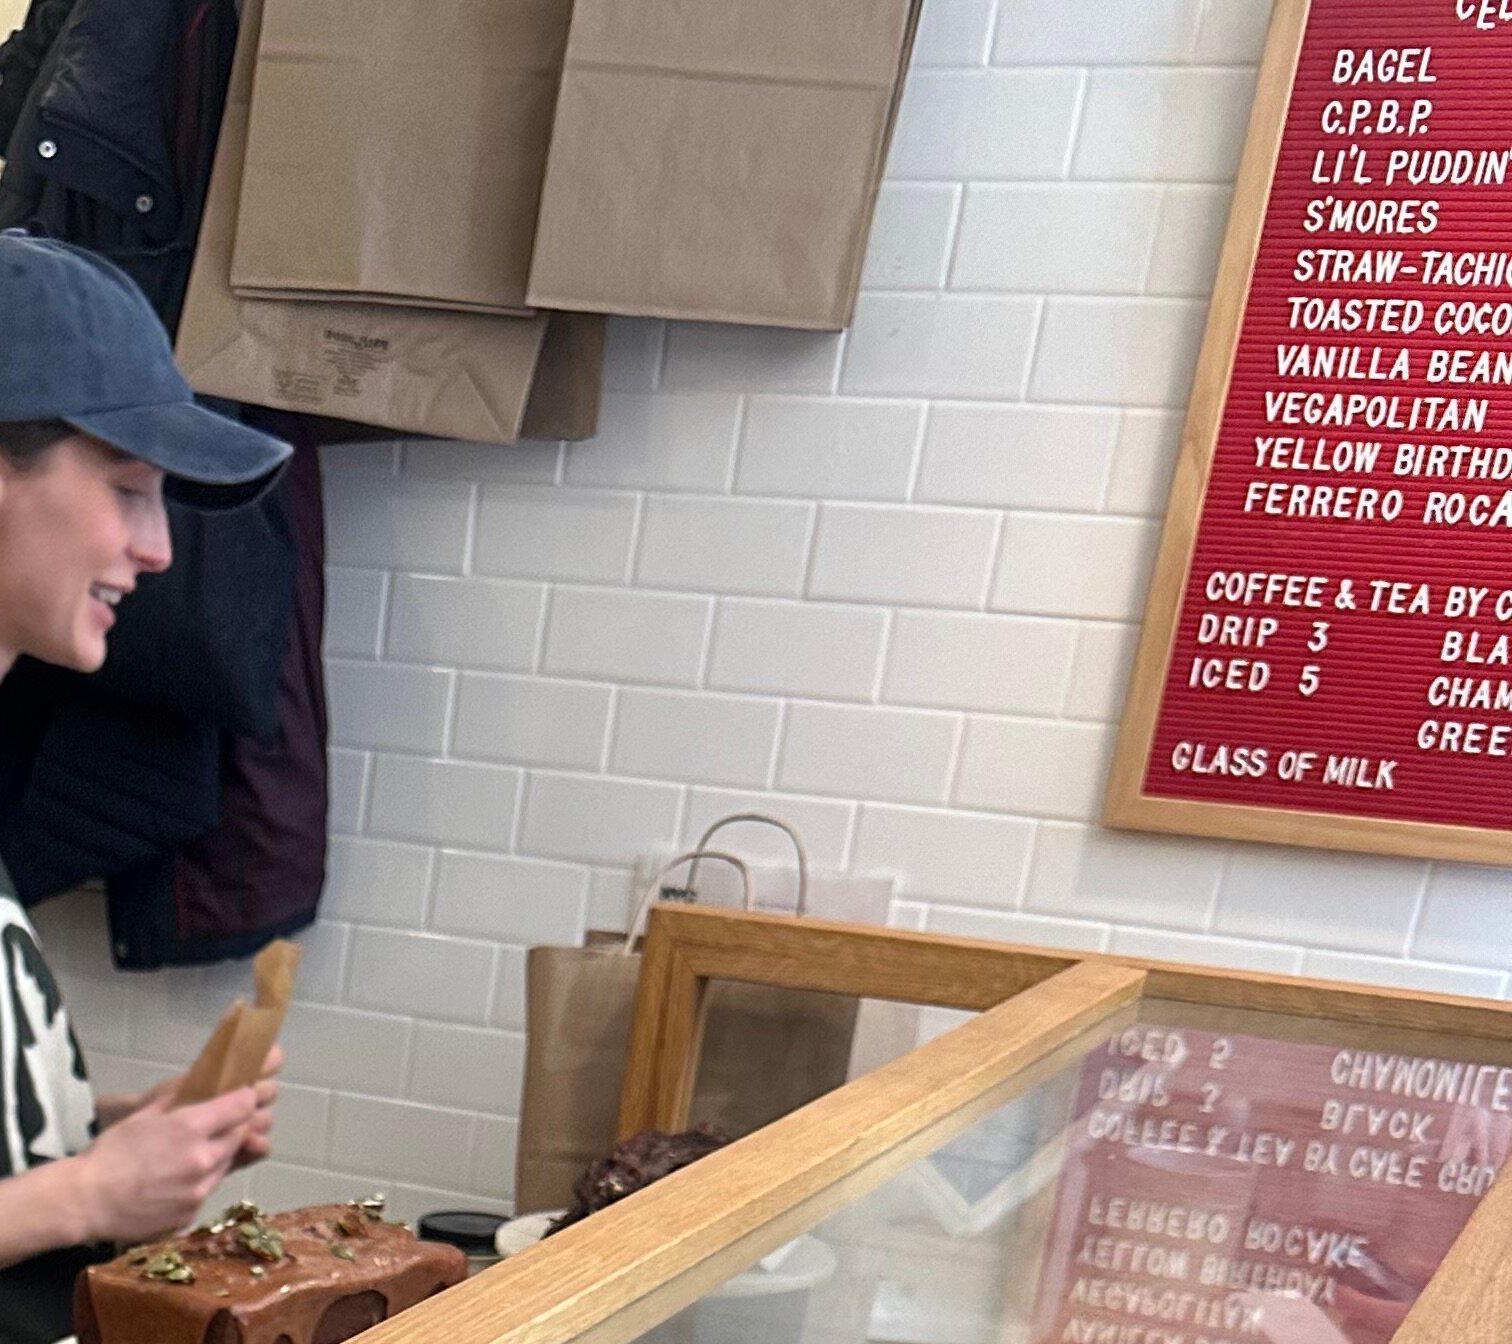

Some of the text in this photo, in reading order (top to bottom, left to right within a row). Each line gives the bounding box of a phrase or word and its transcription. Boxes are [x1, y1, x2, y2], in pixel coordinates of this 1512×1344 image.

[1332, 47, 1437, 83] BAGEL
[1321, 99, 1432, 136] C.P.B.P.
[1311, 143, 1372, 185] LI'L
[1303, 195, 1440, 234] S'MORES
[1293, 248, 1512, 288] STRAW-TACHI
[1288, 297, 1424, 334] TOASTED
[1276, 343, 1512, 385] VANILLA BEAN
[1265, 390, 1489, 433] VEGAPOLITAN
[1254, 436, 1512, 481] YELLOW BIRTHD
[1243, 482, 1512, 528] FERRERO ROCA
[1205, 570, 1328, 609] COFFEE
[1334, 578, 1357, 611] &
[1368, 579, 1430, 615] TEA
[1444, 585, 1489, 619] BY
[1197, 613, 1330, 653] DRIP 3
[1189, 656, 1321, 697] ICED 5
[1171, 742, 1399, 790] GLASS OF MILK
